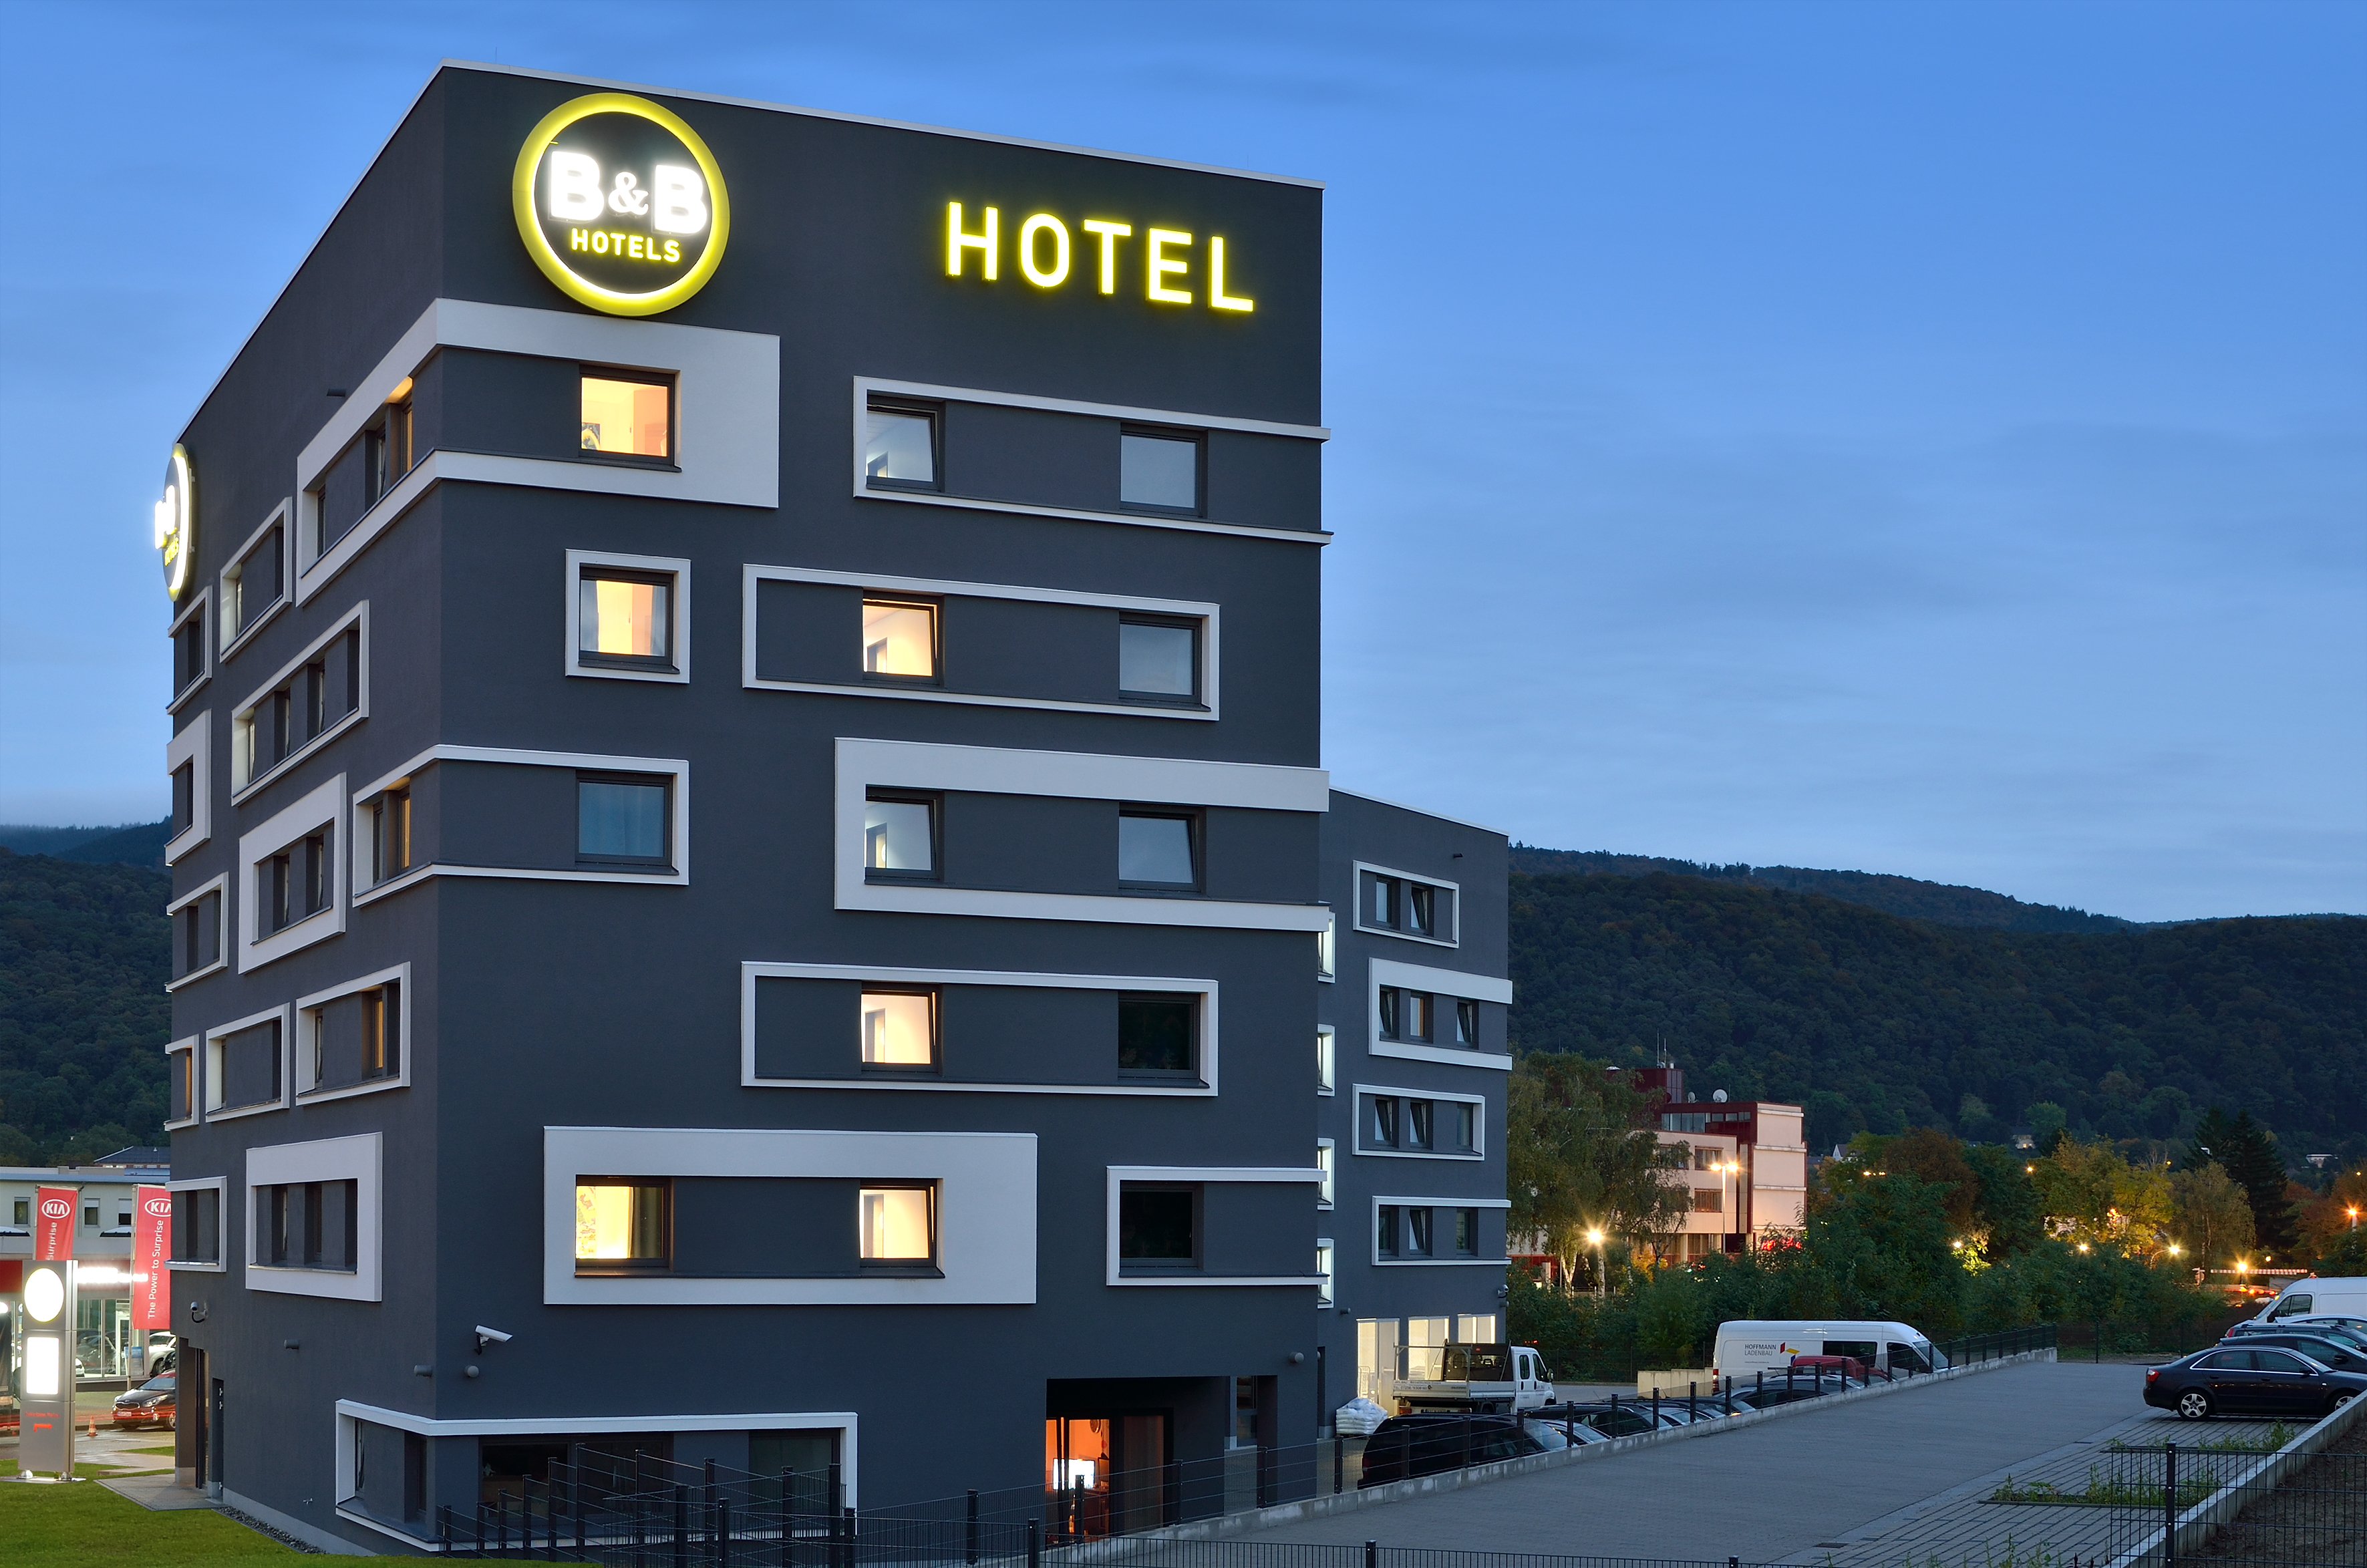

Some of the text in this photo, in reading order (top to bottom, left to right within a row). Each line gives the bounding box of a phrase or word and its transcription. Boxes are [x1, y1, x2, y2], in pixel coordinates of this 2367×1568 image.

[550, 150, 708, 235] B&B
[571, 227, 681, 263] HOTELS
[945, 200, 1254, 313] HOTEL
[46, 1203, 65, 1215] KIA
[45, 1222, 57, 1261] Surprise
[148, 1220, 164, 1319] The Power to Surprise
